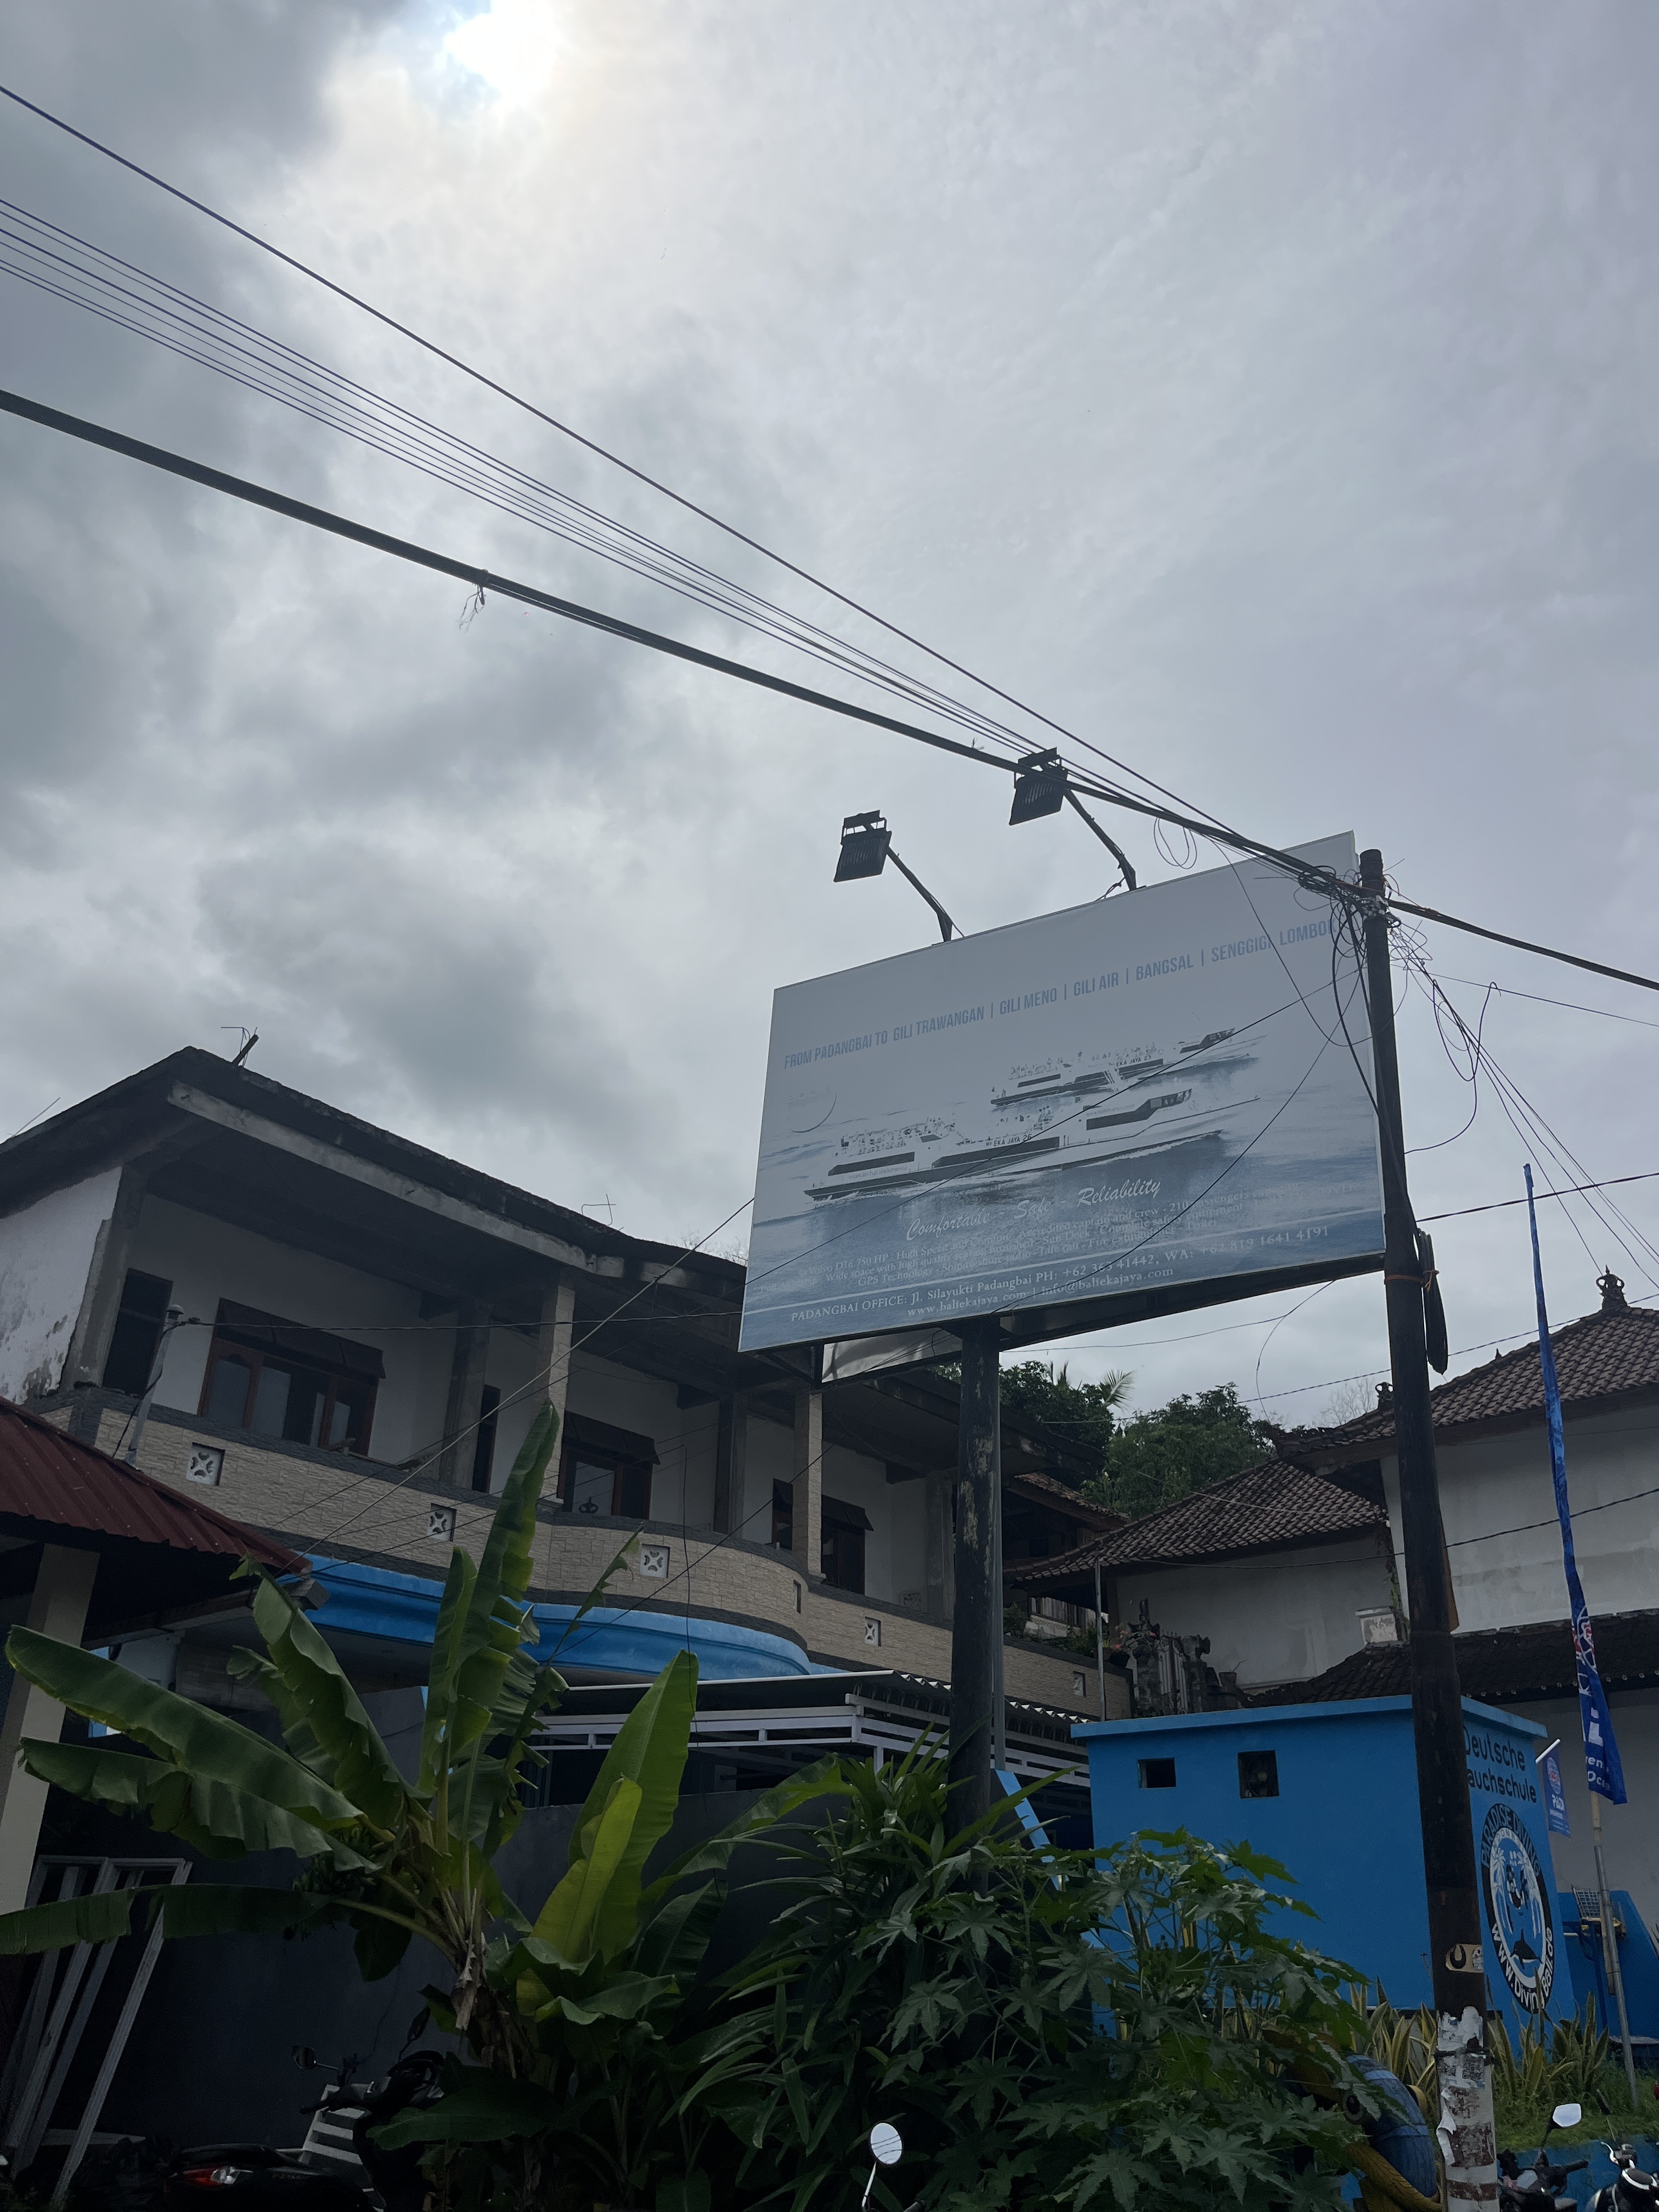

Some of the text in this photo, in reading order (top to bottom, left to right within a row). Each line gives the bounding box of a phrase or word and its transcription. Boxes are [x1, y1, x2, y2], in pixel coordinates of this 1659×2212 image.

[784, 1049, 812, 1069] FROM
[815, 1034, 872, 1062] PADANGBAI
[874, 1030, 888, 1047] TO
[893, 1024, 913, 1042] GILI
[916, 1006, 984, 1035] TRAWANGAN
[1000, 998, 1020, 1015] GILI
[1024, 988, 1058, 1009] MENO
[1074, 978, 1096, 996] GILI
[1099, 972, 1120, 990] AIR
[1136, 954, 1194, 981] BANGSAL
[1211, 934, 1273, 962] SENGGIGI
[1279, 918, 1338, 946] LOMBOK
[1007, 1136, 1020, 1144] JAYA
[1023, 1133, 1032, 1142] 26
[808, 1263, 833, 1275] Volvo
[835, 1261, 854, 1271] D16
[856, 1256, 872, 1266] 750
[874, 1254, 889, 1263] HP
[896, 1249, 918, 1261] High
[1113, 1210, 1132, 1222] and
[1135, 1207, 1159, 1218] crew
[1169, 1200, 1189, 1212] 210
[906, 1208, 991, 1242] Comfortable
[1014, 1197, 1052, 1221] Safe
[1077, 1179, 1161, 1207] Reliability
[791, 1226, 1328, 1322] PADANGBAI OFFICE: Jl. Silayukti Padangbai PH: +62 363 41442, WA: +62 819 1641 4191
[851, 1267, 874, 1279] space
[877, 1262, 896, 1273] with
[899, 1259, 918, 1271] high
[921, 1252, 952, 1268] quality
[858, 1274, 879, 1286] GPS
[882, 1266, 934, 1283] Technology
[907, 1290, 1027, 1316] www.baliekajaya.com
[1042, 1267, 1173, 1295] info@baliekajaya.com
[1468, 1768, 1537, 1804] auchschule
[1481, 1804, 1513, 1869] PARADISE
[1513, 1813, 1542, 1877] DIVING
